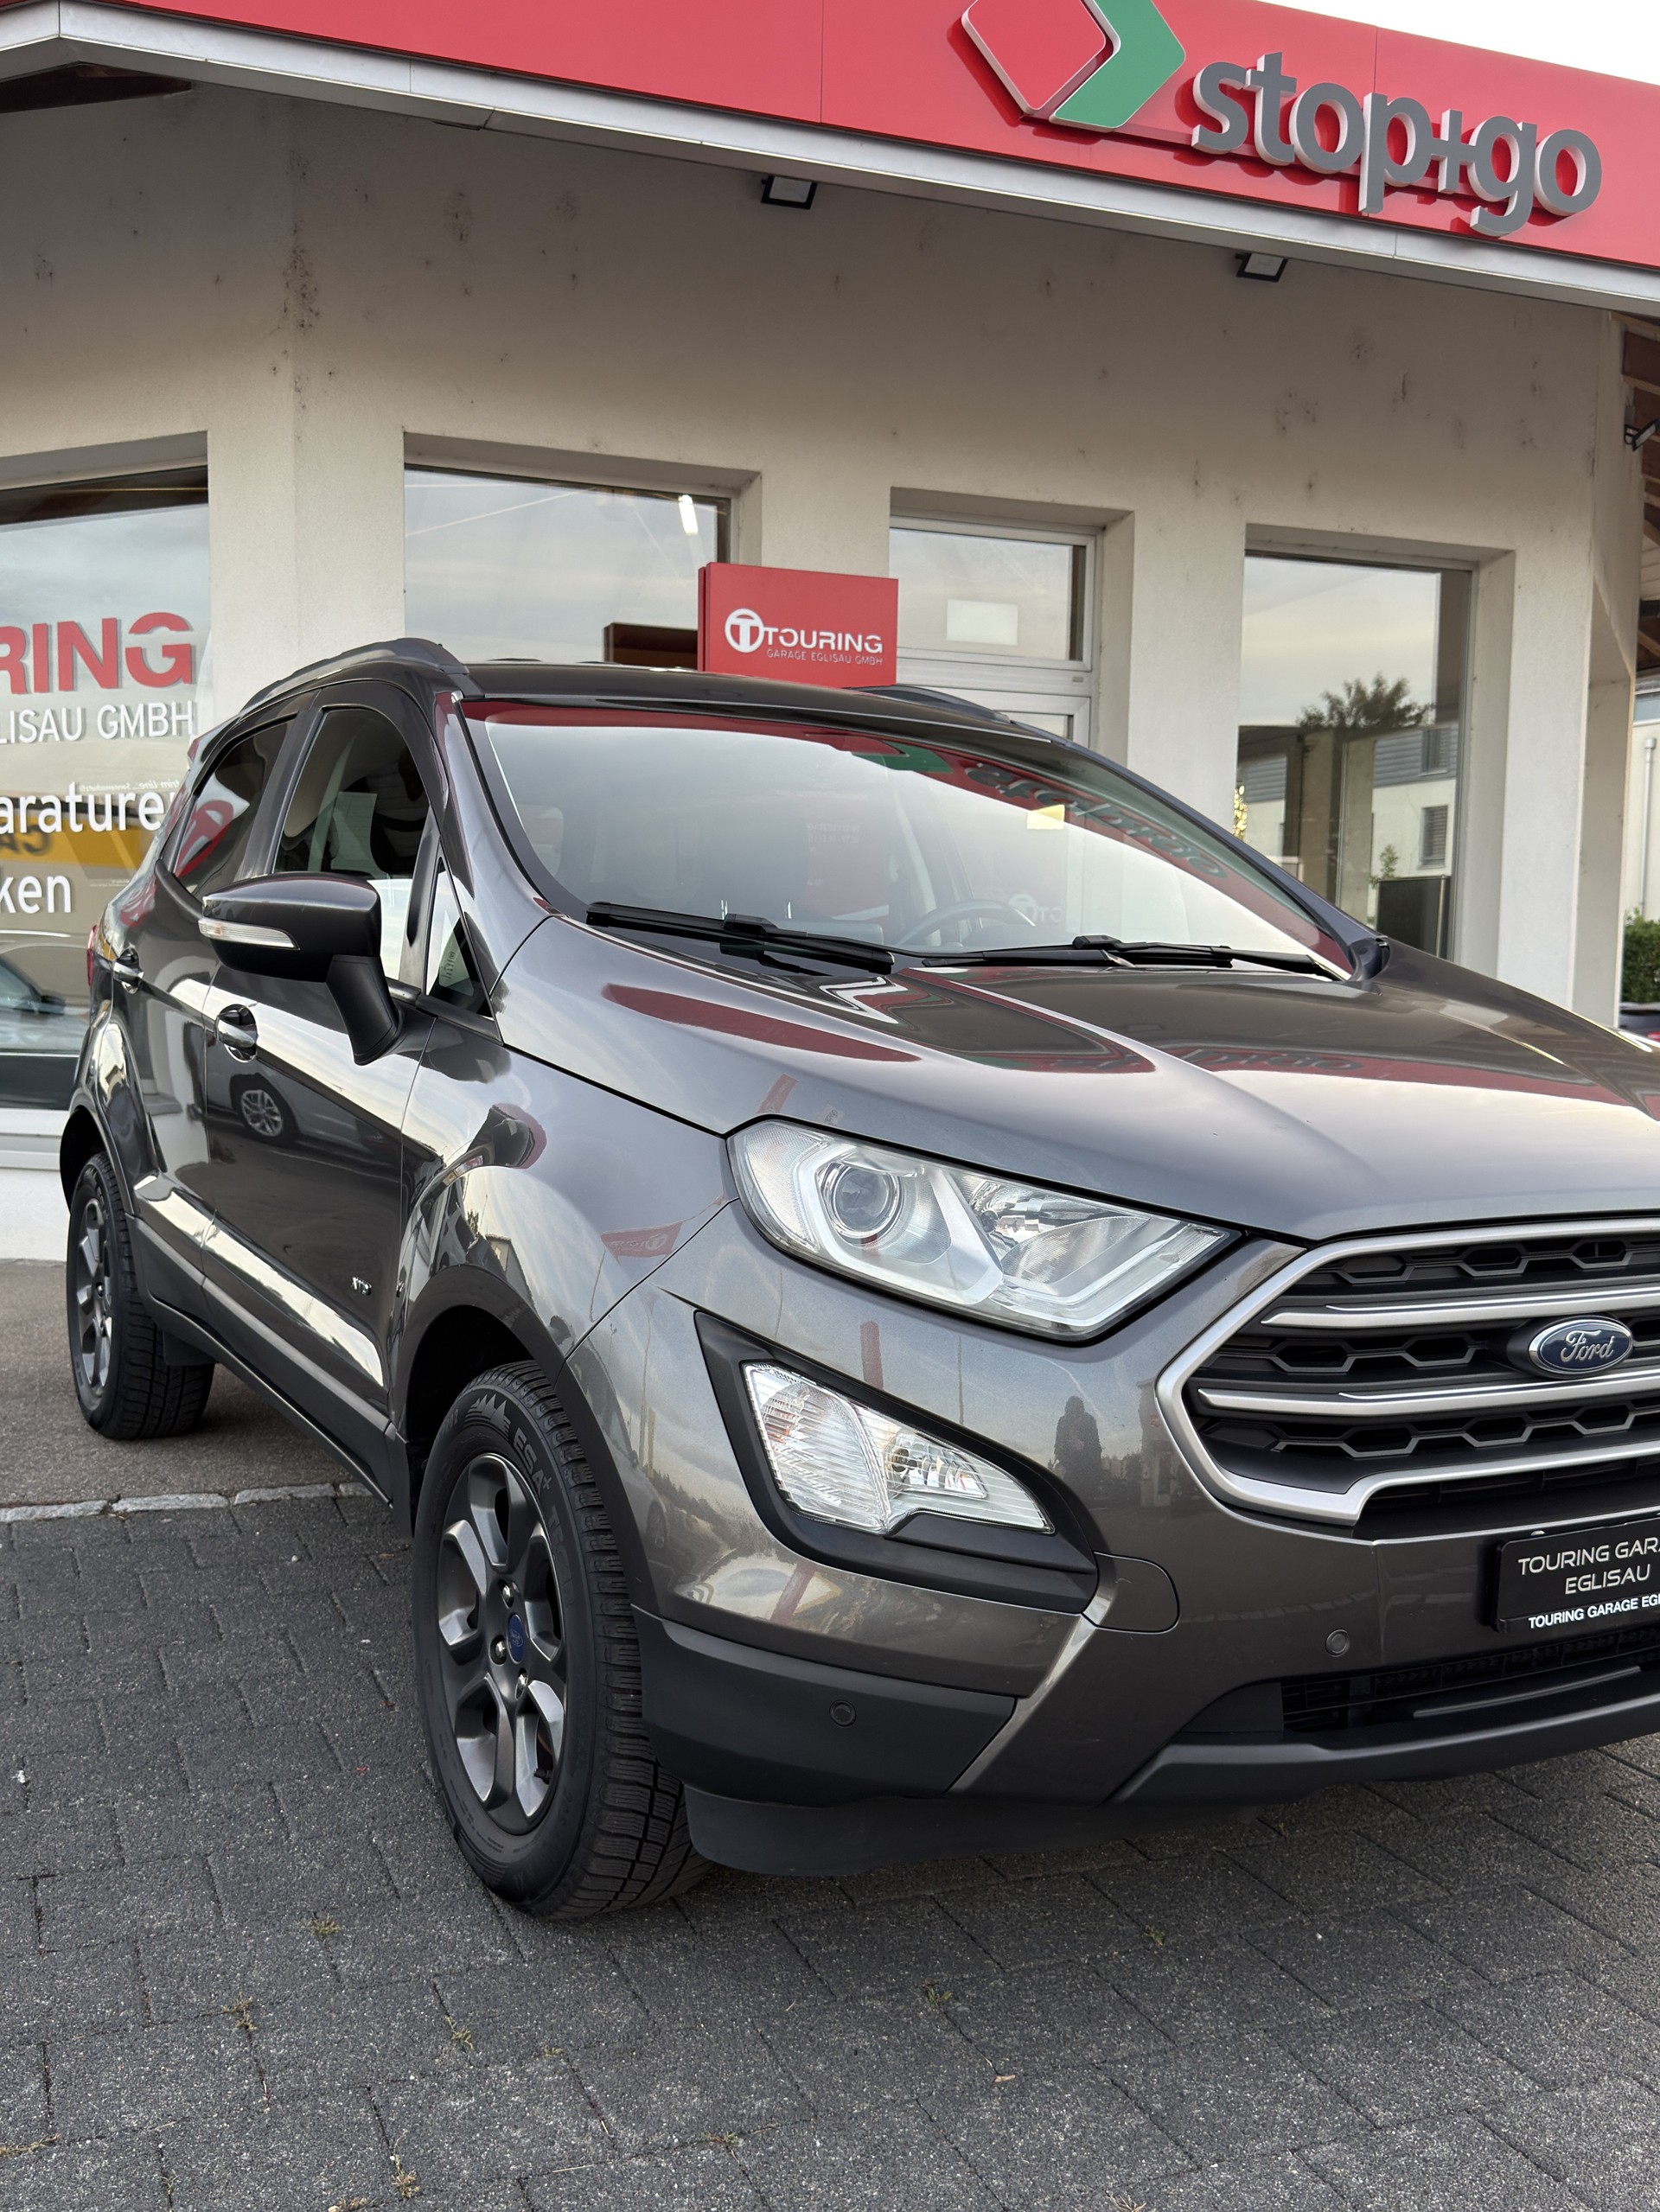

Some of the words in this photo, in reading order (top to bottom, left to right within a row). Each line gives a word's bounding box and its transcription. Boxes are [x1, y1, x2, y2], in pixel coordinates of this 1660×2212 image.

[1191, 51, 1602, 237] stop+go
[763, 627, 883, 653] TOURING
[767, 649, 807, 660] GARAGE
[811, 652, 852, 664] EGLISAU
[855, 655, 883, 666] GMBH
[97, 700, 194, 740] GMBH
[1560, 1329, 1615, 1363] Ford
[1518, 1545, 1610, 1576] TOURING
[1615, 1537, 1660, 1559] GAR
[1565, 1564, 1650, 1595] EGLISAU
[1529, 1609, 1584, 1629] TOURING
[1587, 1597, 1638, 1618] GARAGE
